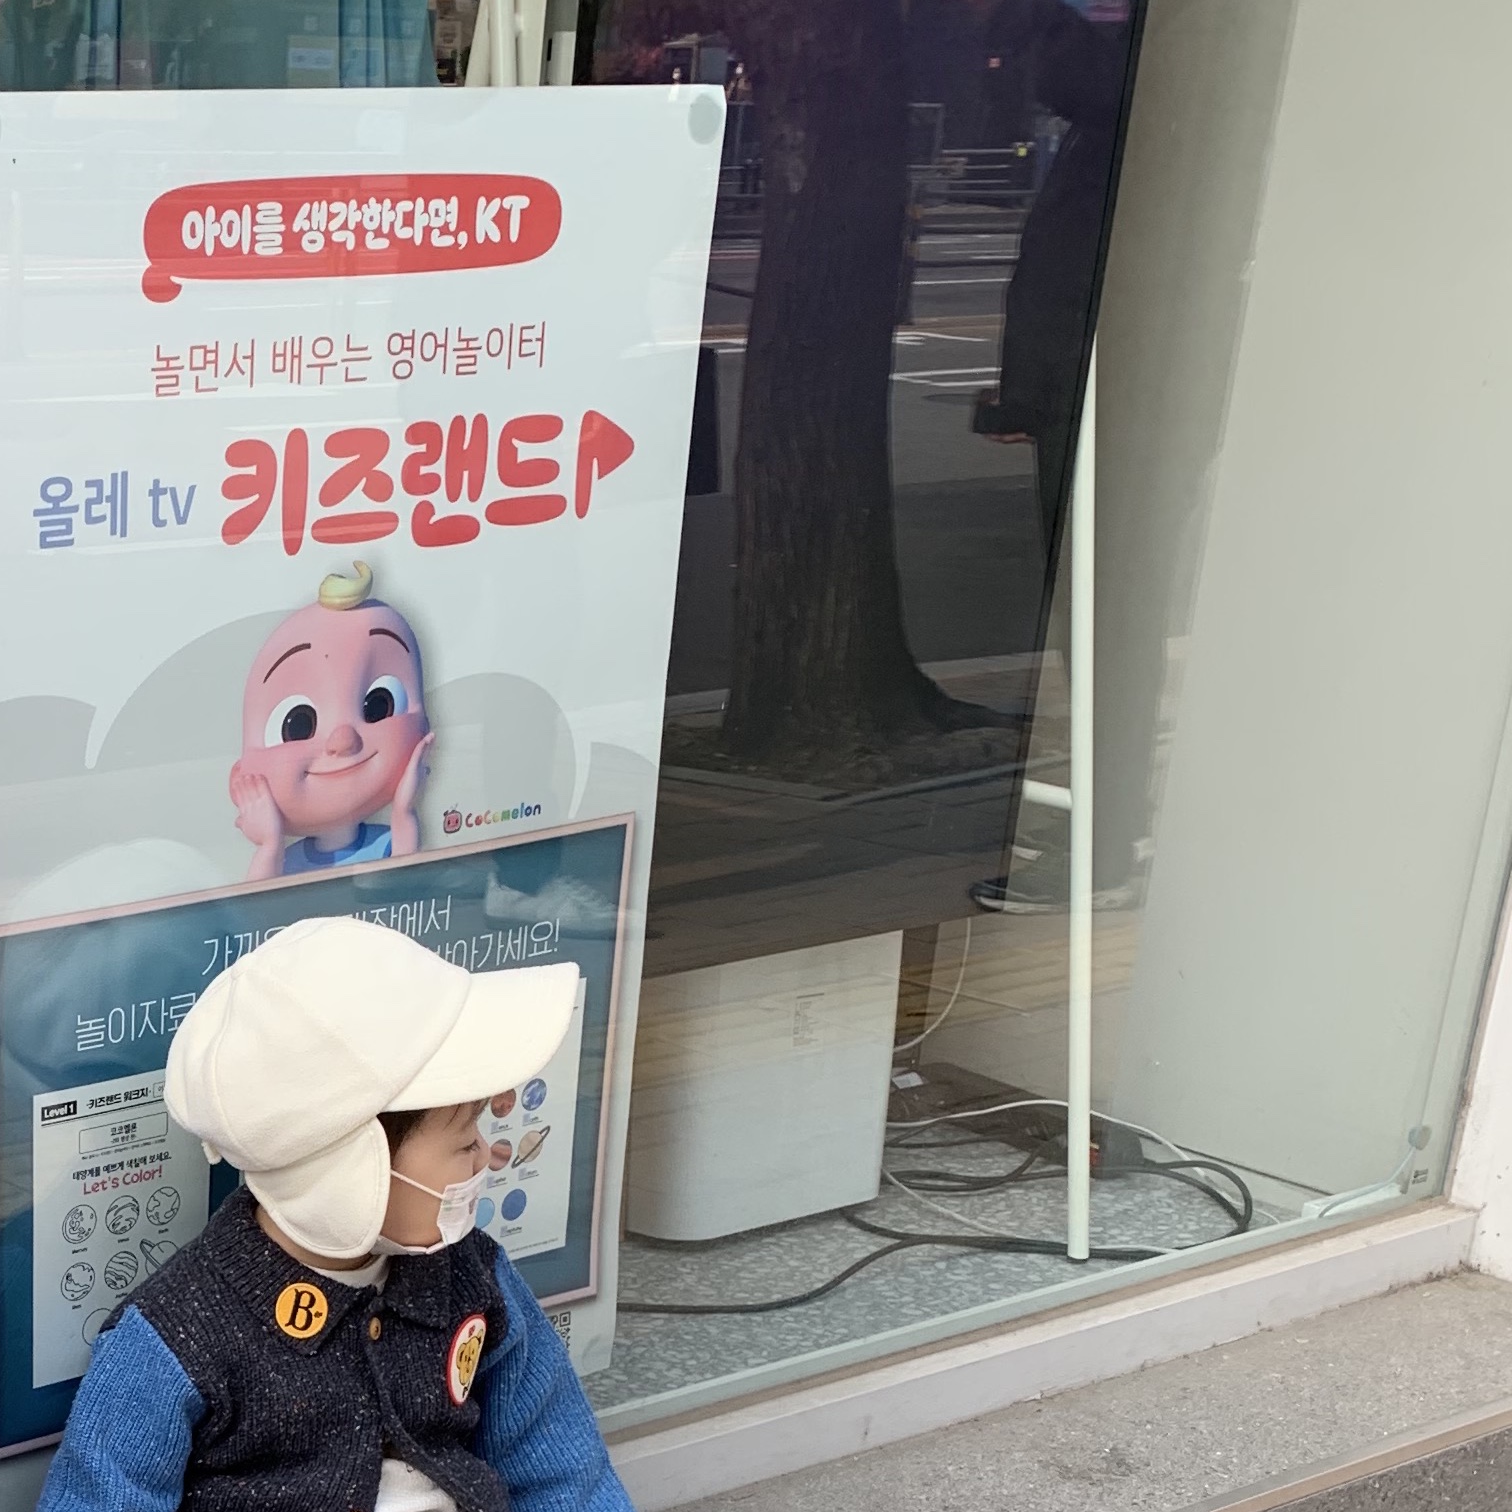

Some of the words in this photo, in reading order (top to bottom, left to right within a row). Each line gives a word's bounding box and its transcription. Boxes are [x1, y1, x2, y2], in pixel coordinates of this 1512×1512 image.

[181, 201, 286, 256] 아이를
[292, 195, 468, 253] 생각한다면,
[476, 195, 531, 243] KT
[151, 338, 256, 398] 놀면서
[271, 333, 373, 386] 배우는
[387, 321, 547, 381] 영어놀이터
[33, 470, 130, 549] 올레
[148, 478, 197, 528] tv
[220, 412, 568, 557] 키즈랜드
[44, 1105, 68, 1119] Level
[68, 1104, 75, 1114] 1
[83, 1176, 120, 1195] Let's
[122, 1165, 163, 1186] Color!
[102, 1160, 125, 1174] 예쁘게
[285, 1288, 317, 1332] B
